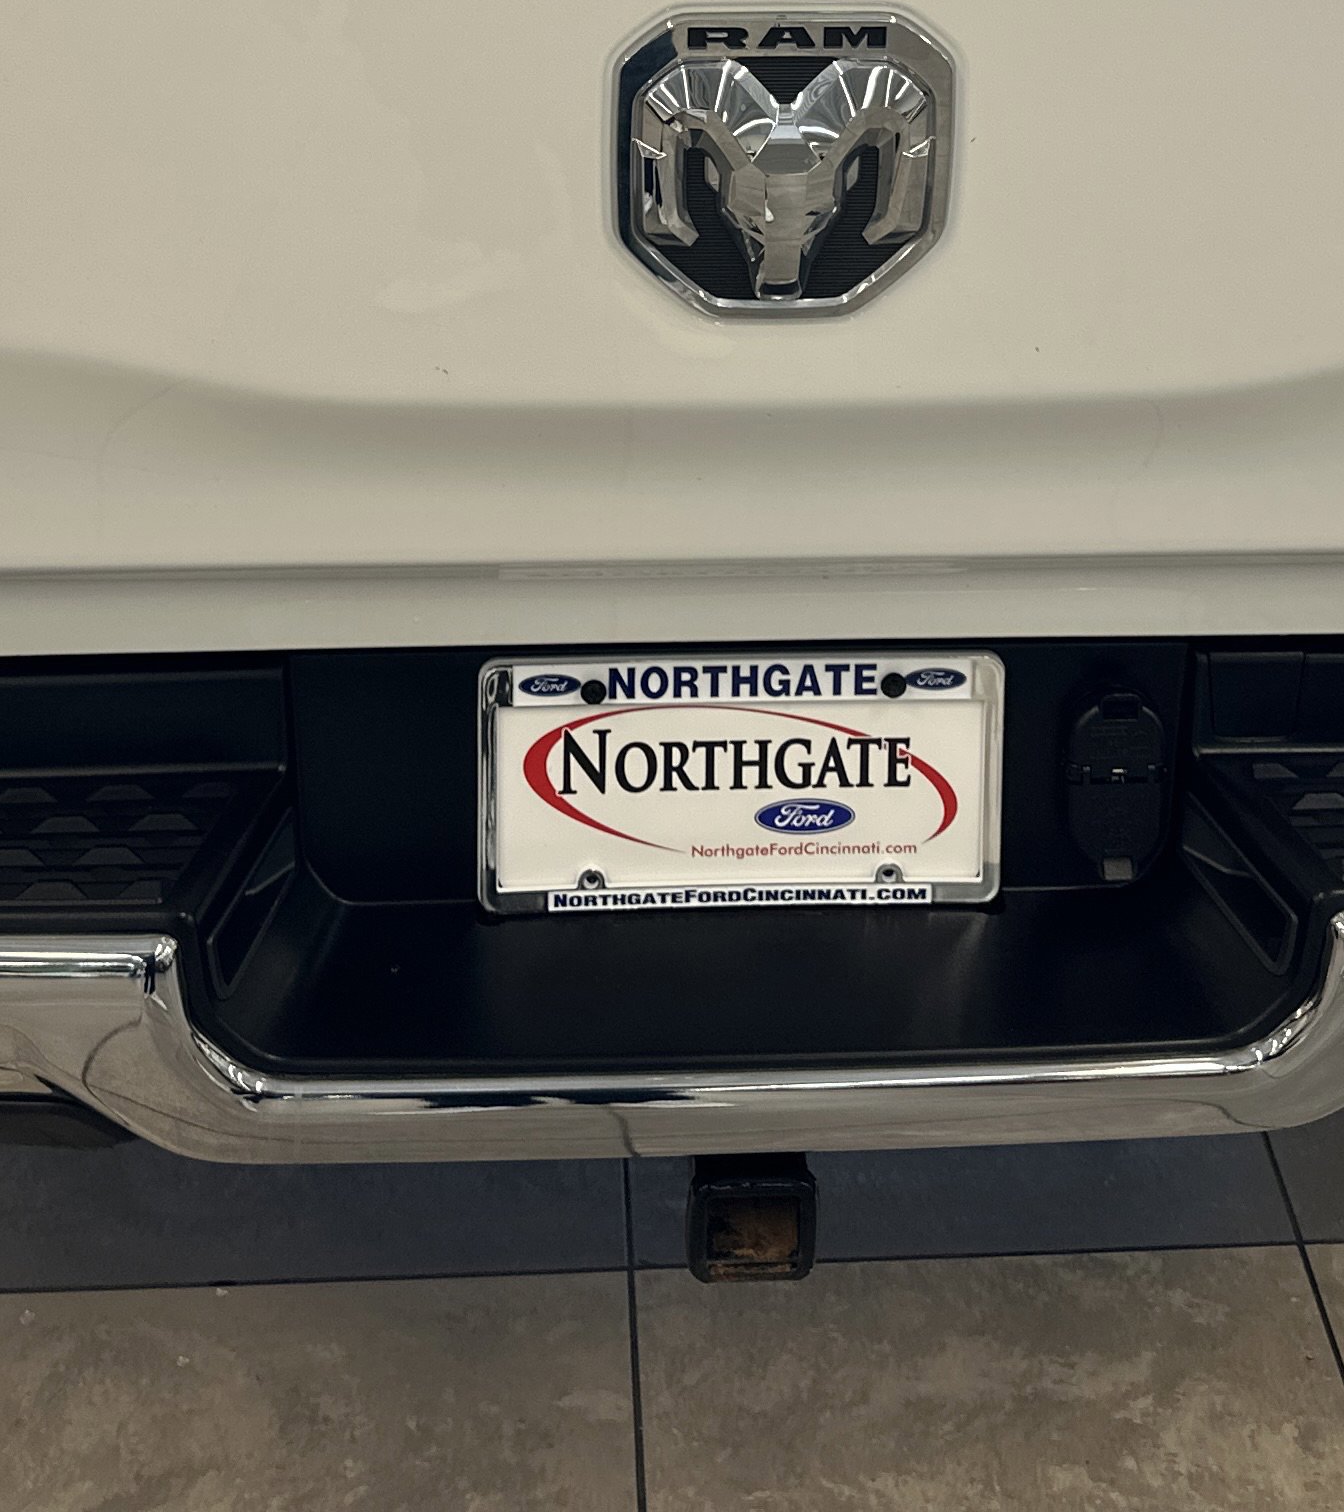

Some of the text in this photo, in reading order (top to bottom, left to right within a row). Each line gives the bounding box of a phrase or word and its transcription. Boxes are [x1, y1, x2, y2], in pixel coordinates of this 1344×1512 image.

[686, 25, 888, 51] RAM
[607, 663, 878, 700] NORTHGATE
[557, 727, 912, 795] NORTHGATE
[773, 801, 835, 829] Ford
[690, 840, 918, 859] NorthgateFordCincinnati.com
